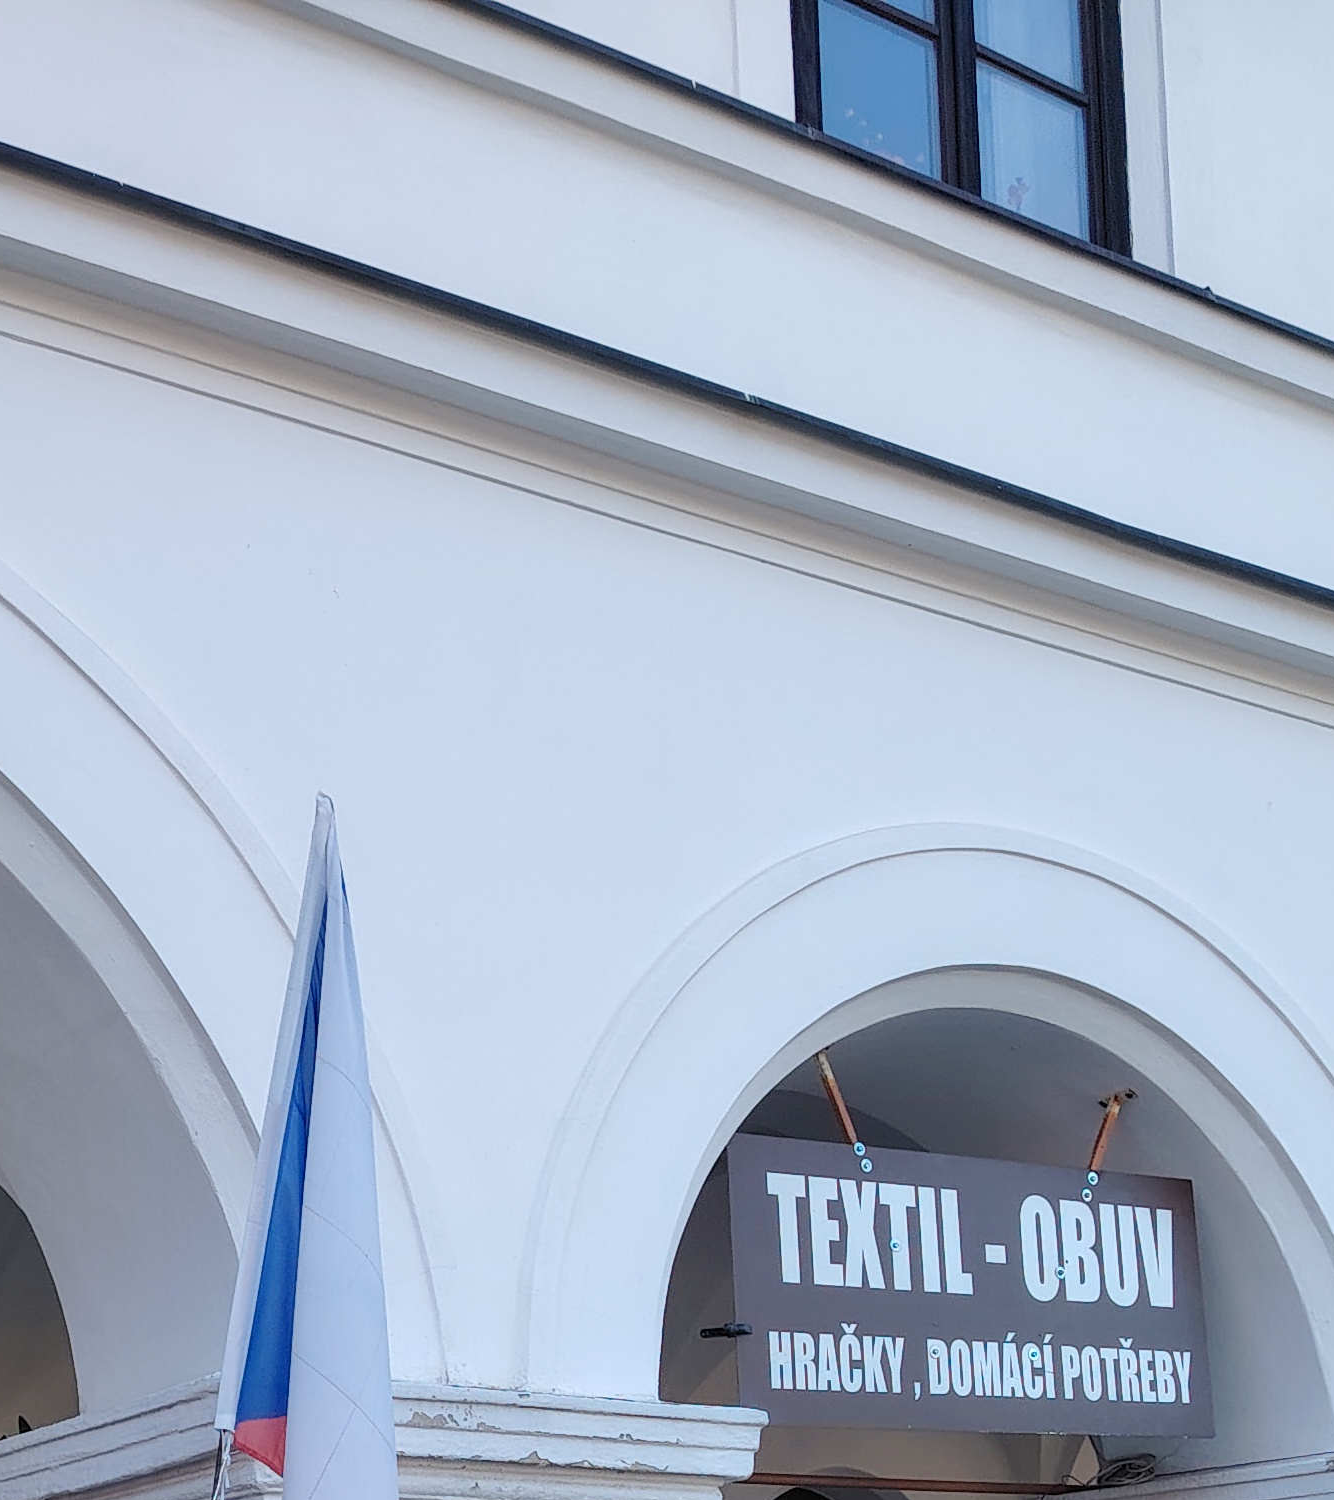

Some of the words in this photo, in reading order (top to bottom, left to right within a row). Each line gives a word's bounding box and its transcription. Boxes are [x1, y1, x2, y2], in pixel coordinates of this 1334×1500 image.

[767, 1172, 974, 1296] TEXTIL
[1019, 1194, 1175, 1309] OBUV
[927, 1331, 1057, 1400] DOMÁCÍ
[1062, 1337, 1192, 1405] POTŘEBY
